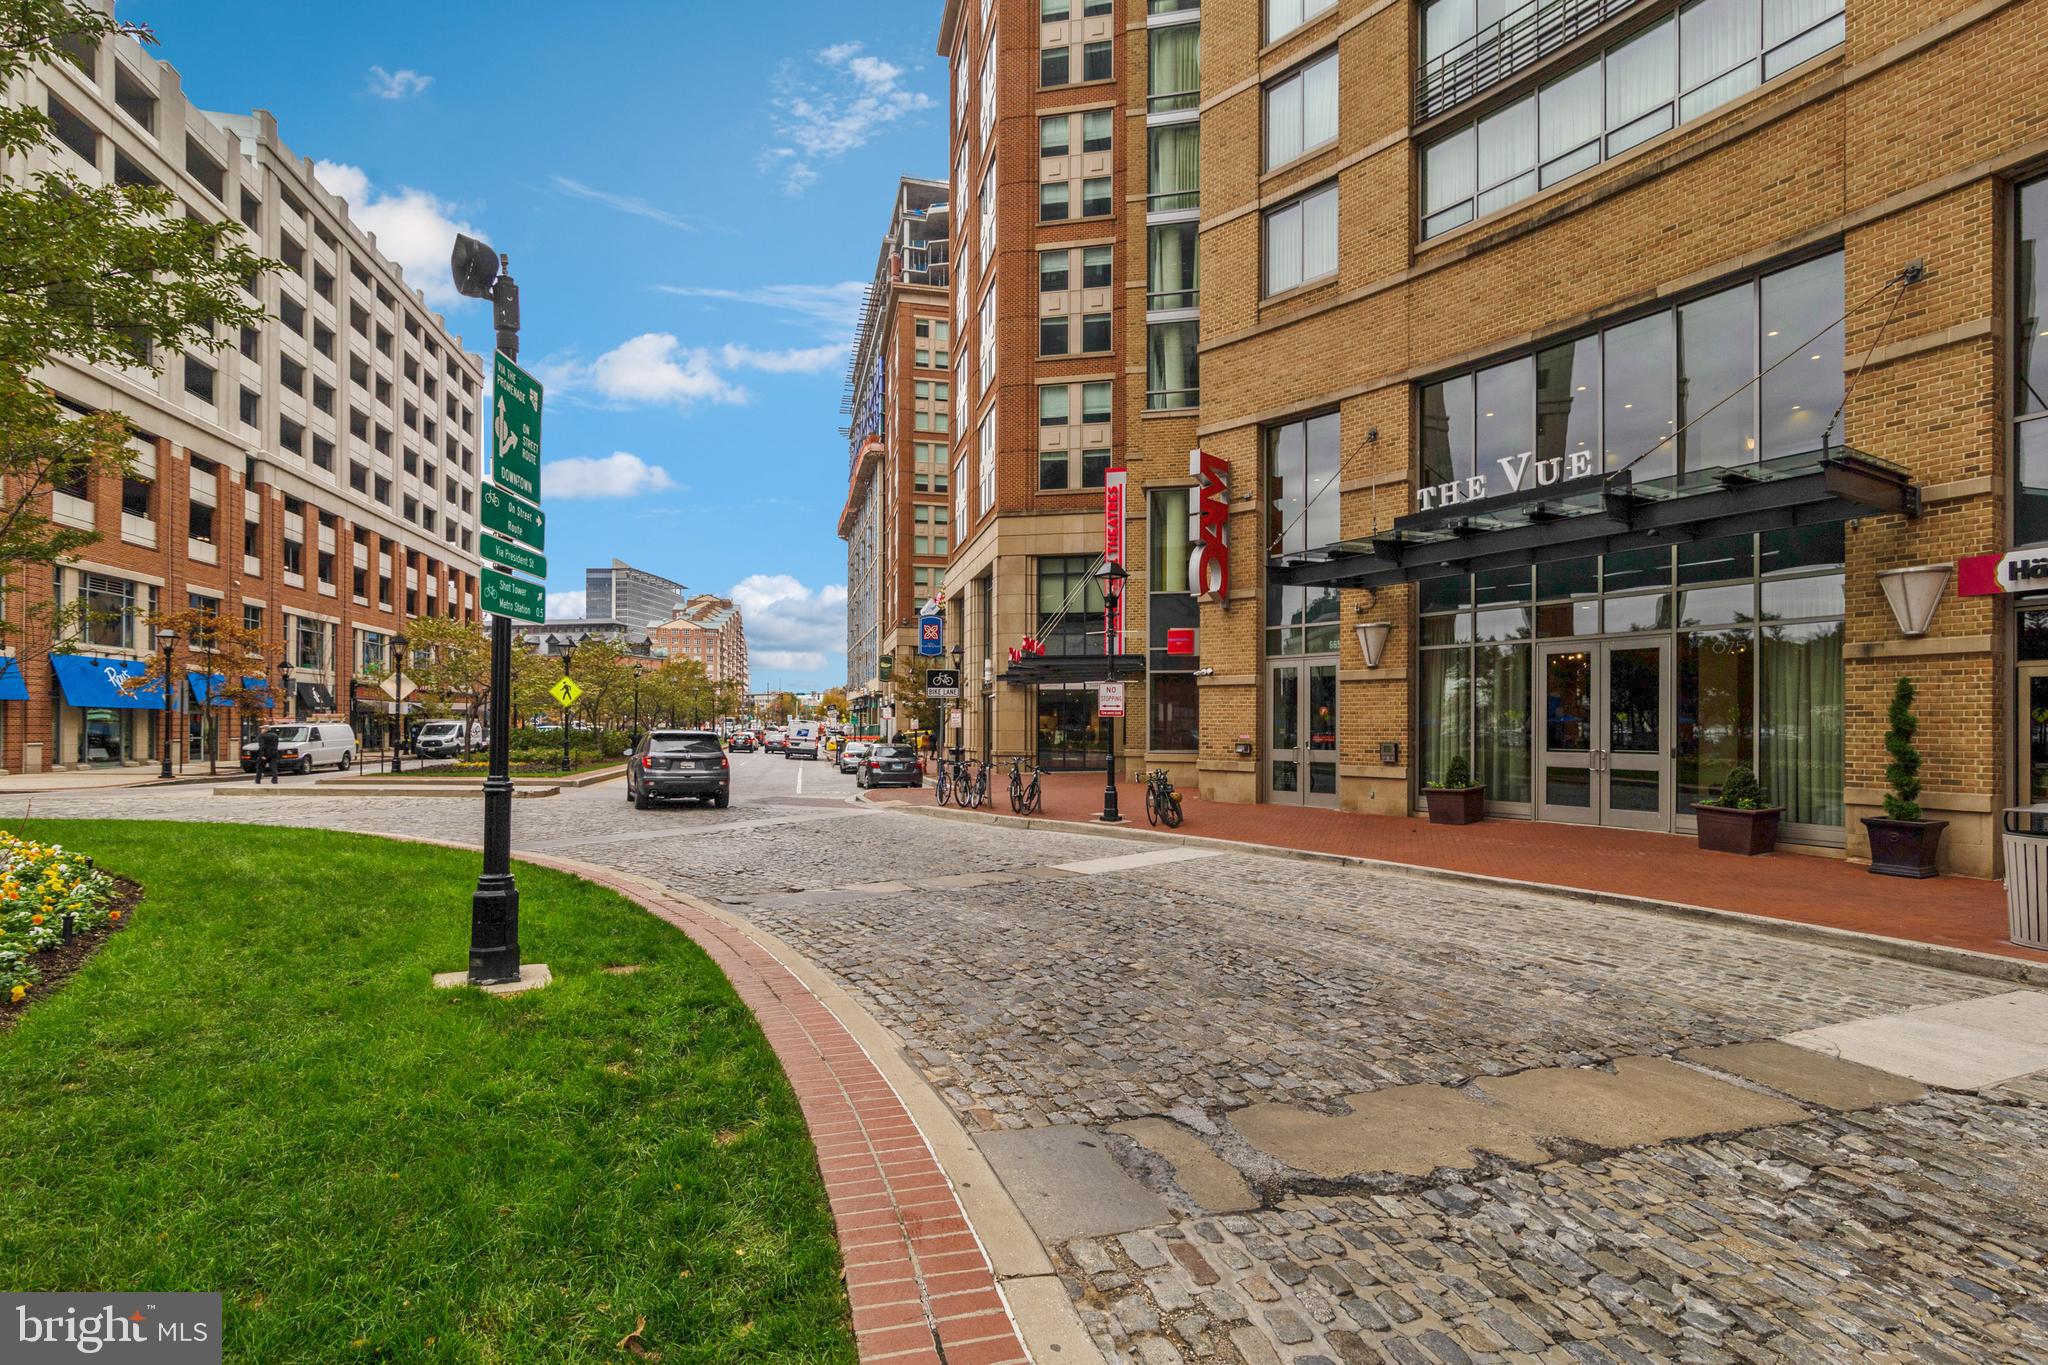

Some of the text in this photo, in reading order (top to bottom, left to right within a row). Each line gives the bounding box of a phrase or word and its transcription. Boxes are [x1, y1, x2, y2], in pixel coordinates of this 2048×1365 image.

[498, 361, 516, 384] VIA THE
[497, 374, 526, 404] PROMENADE
[523, 424, 530, 435] ON
[523, 436, 539, 453] STREET
[523, 448, 537, 466] ROUTE
[501, 467, 533, 494] DOWNTOWN
[1417, 449, 1593, 512] THE VUE
[508, 502, 532, 522] On Street
[1107, 486, 1118, 556] THEATRES
[508, 520, 522, 535] Route
[496, 545, 535, 568] Via President St
[500, 580, 526, 596] Shot Tower
[500, 598, 513, 610] Metro
[514, 602, 531, 614] Station
